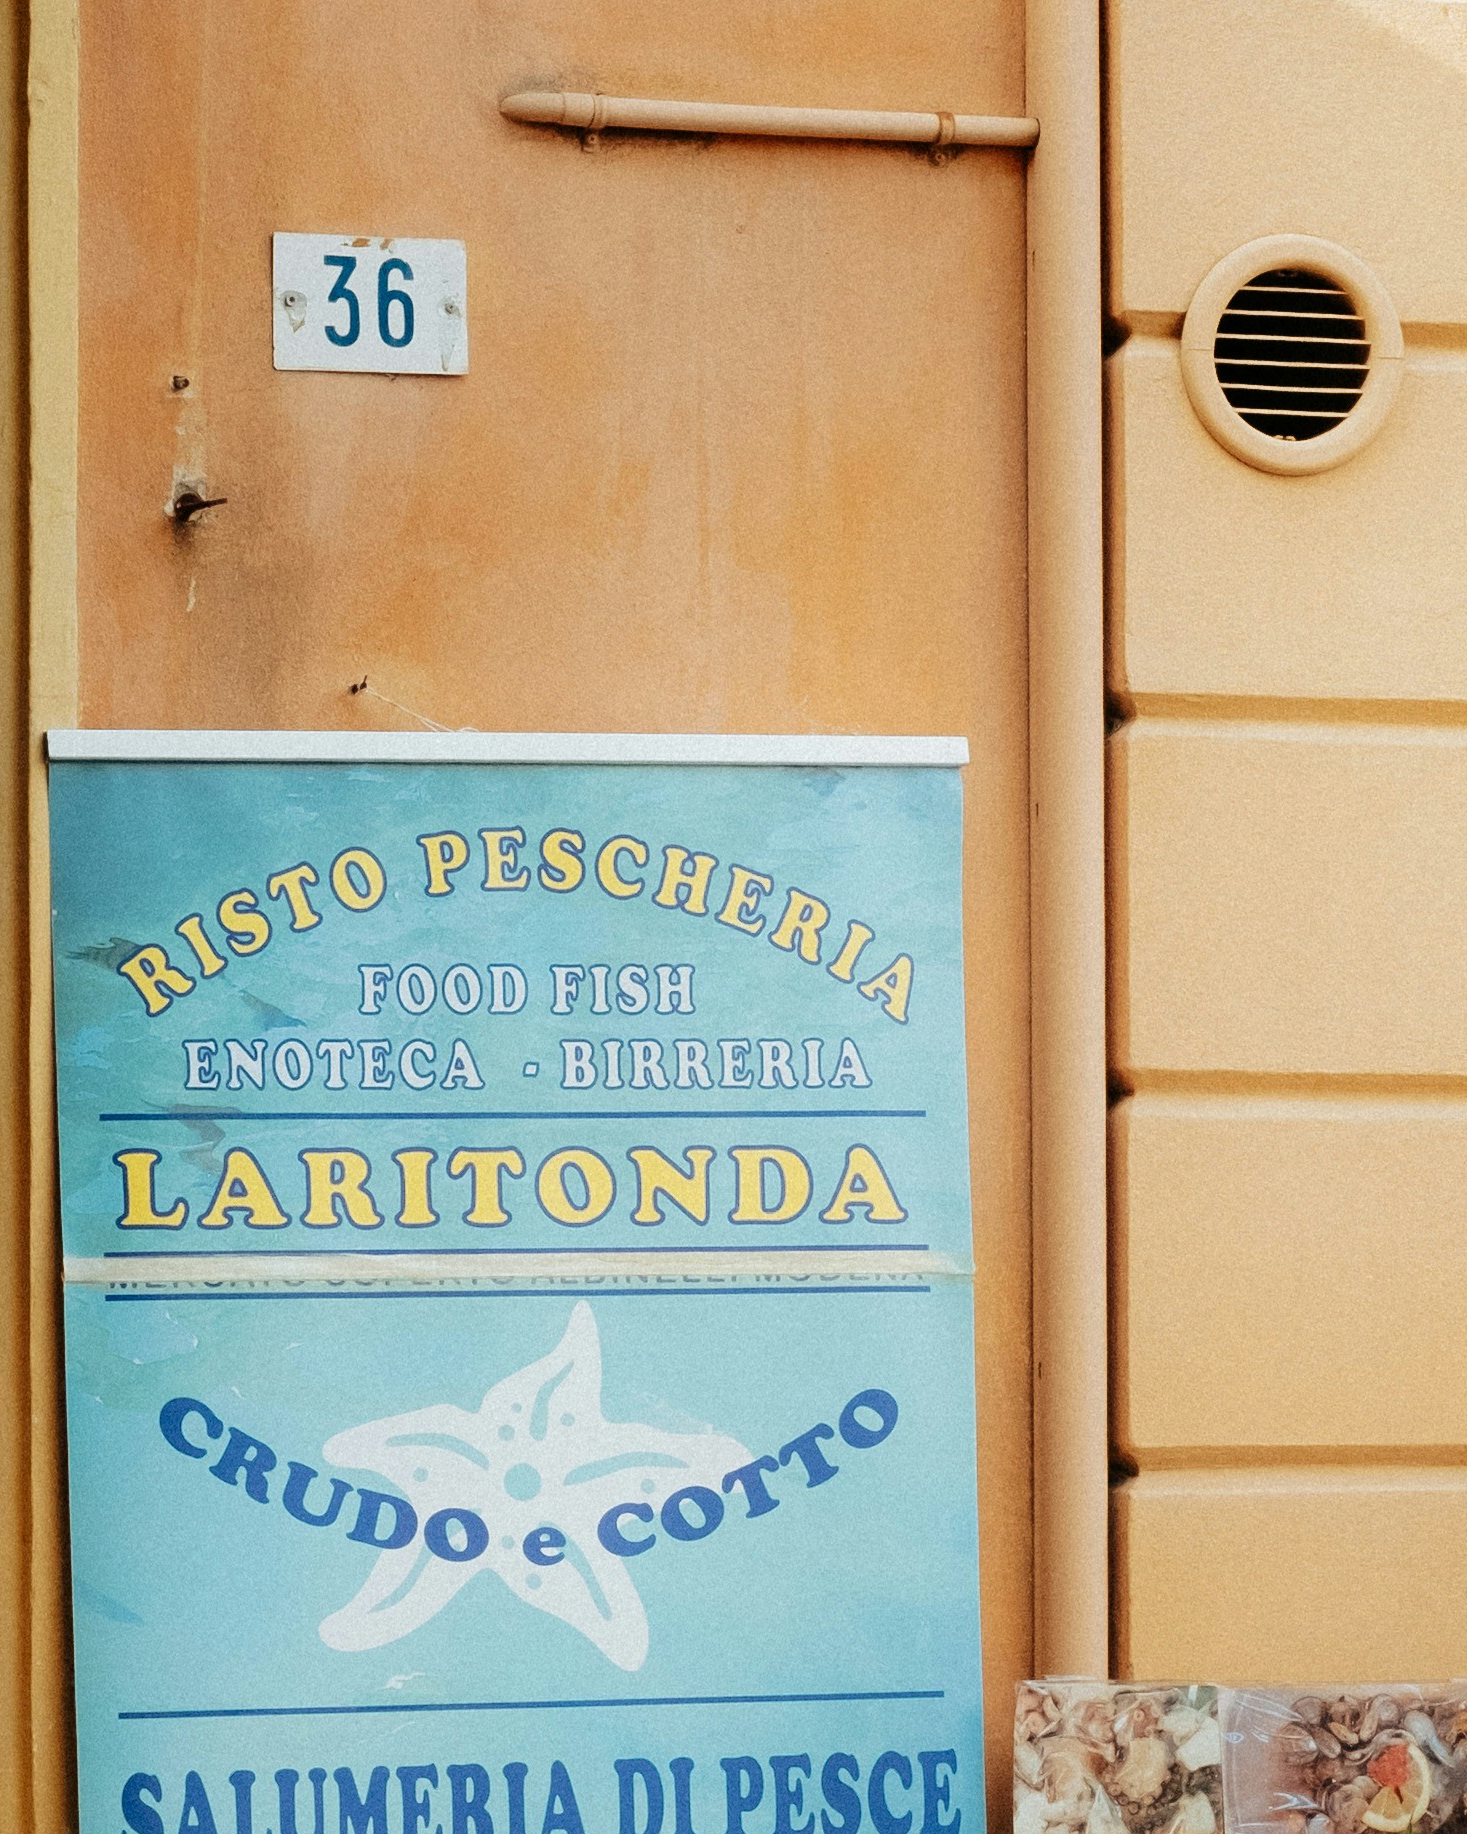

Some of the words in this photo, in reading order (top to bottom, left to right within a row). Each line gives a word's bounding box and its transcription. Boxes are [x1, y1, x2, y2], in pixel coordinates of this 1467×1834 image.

[323, 255, 414, 348] 36
[118, 846, 386, 1017] RISTO
[419, 825, 916, 1023] PESCHERIA
[358, 963, 528, 1016] FOOD
[551, 963, 696, 1016] FISH
[183, 1038, 485, 1091] ENOTECA
[561, 1037, 873, 1090] BIRRERIA
[112, 1144, 909, 1230] LARITONDA
[157, 1396, 491, 1564] CRUDO
[522, 1519, 567, 1566] e
[596, 1387, 901, 1557] COTTO
